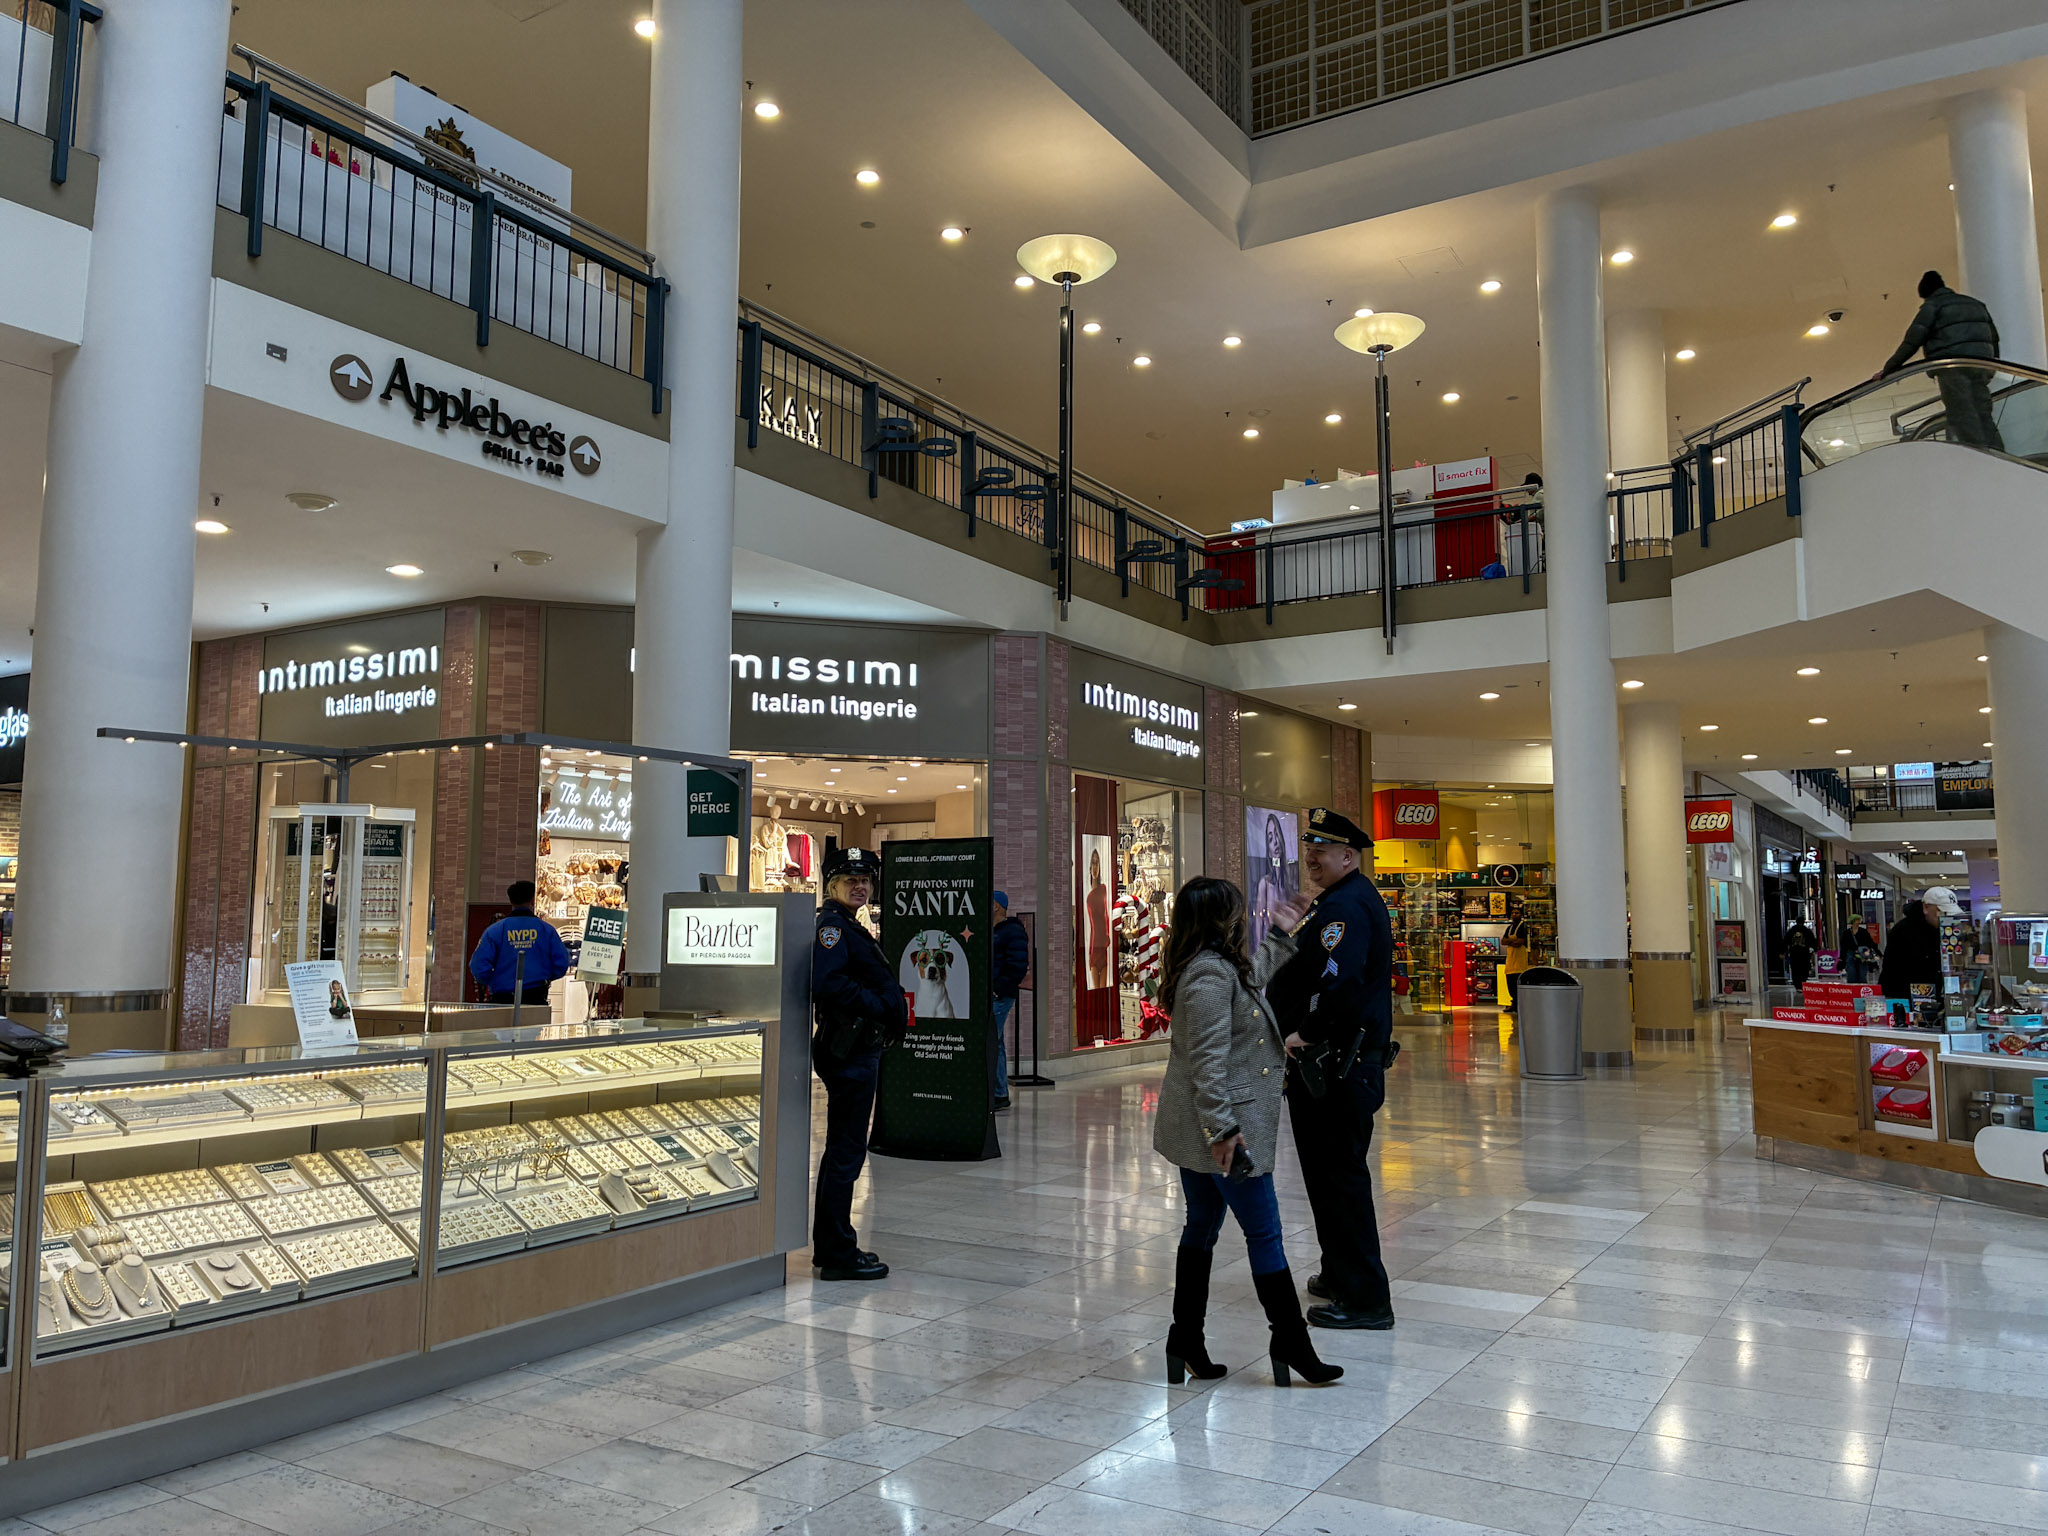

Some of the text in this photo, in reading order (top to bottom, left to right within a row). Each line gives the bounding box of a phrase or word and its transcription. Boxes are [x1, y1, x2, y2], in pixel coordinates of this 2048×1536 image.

[459, 203, 471, 214] BY
[380, 357, 567, 457] Applebee's
[761, 385, 823, 434] KAY
[482, 440, 523, 465] GRILL
[537, 458, 564, 477] BAR
[1446, 467, 1487, 480] smart fix
[258, 645, 438, 694] intimissimi
[325, 685, 437, 717] Italian lingerie
[752, 691, 918, 720] Italian lingerie
[1084, 682, 1199, 731] intimissimi
[1134, 727, 1200, 758] Italian lingerie
[560, 781, 632, 817] The Art of
[690, 791, 713, 803] GET
[690, 803, 731, 814] PIERCE
[1397, 804, 1435, 823] LEGO
[539, 807, 632, 840] Italian Ling
[1690, 814, 1729, 831] LEGO
[896, 879, 974, 889] PET PHOTOS WITH
[1837, 872, 1861, 880] verizon
[1860, 889, 1884, 899] Lids
[894, 890, 976, 916] SANTA
[590, 917, 622, 935] FREE
[685, 915, 758, 948] Banter
[507, 929, 538, 941] NYPD
[599, 932, 619, 940] PIERCING
[1803, 985, 1824, 993] CINNABON
[1828, 986, 1853, 994] CINNABON
[1804, 998, 1854, 1007] CINNABON CINNABON
[1776, 1010, 1847, 1023] CINNABON CINNABON
[946, 1034, 964, 1043] friends
[937, 1043, 953, 1052] photo
